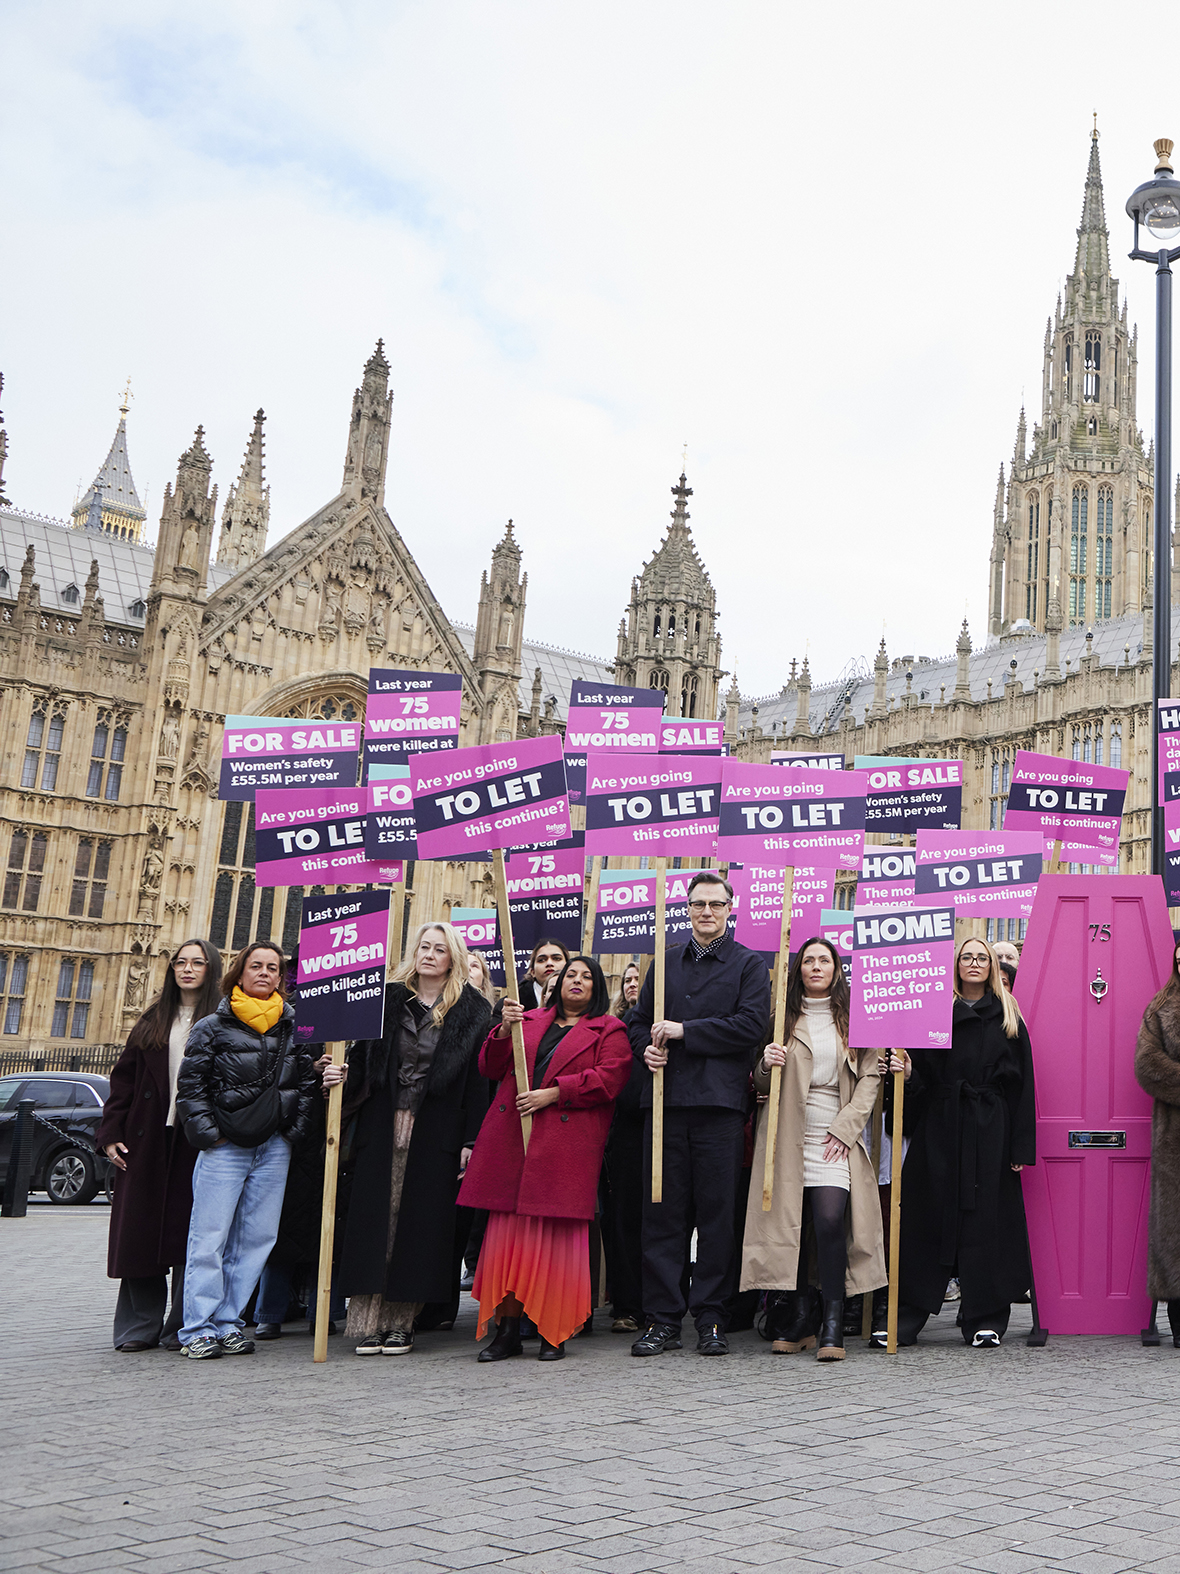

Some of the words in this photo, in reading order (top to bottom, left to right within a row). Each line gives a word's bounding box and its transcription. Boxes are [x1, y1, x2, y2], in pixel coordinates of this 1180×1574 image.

[376, 680, 401, 690] Last
[404, 681, 432, 691] year
[400, 697, 428, 714] 75
[578, 693, 603, 703] Last
[606, 696, 634, 705] year
[369, 716, 456, 732] women
[601, 712, 629, 729] 75
[228, 733, 284, 752] FOR
[292, 729, 356, 749] SALE
[368, 744, 400, 752] were
[403, 739, 438, 750] killed
[440, 740, 453, 748] at
[569, 733, 656, 746] women
[663, 728, 719, 746] SALE
[230, 760, 290, 772] Women's
[294, 758, 333, 768] safety
[231, 774, 282, 786] £55.5M
[285, 774, 308, 784] per
[310, 772, 339, 783] year
[417, 778, 442, 791] Are
[444, 770, 472, 786] you
[475, 758, 517, 778] going
[1016, 770, 1036, 779] Are
[1038, 773, 1058, 782] you
[1061, 773, 1093, 785] going
[435, 791, 480, 820] TO
[488, 772, 542, 807] LET
[726, 786, 750, 796] Are
[754, 786, 780, 798] you
[784, 782, 823, 796] going
[1026, 789, 1058, 808] TO
[1066, 792, 1107, 811] LET
[464, 822, 492, 837] this
[495, 800, 565, 830] continue?
[742, 806, 783, 828] TO
[792, 804, 844, 826] LET
[1041, 816, 1060, 826] this
[1063, 818, 1117, 829] continue?
[546, 822, 566, 830] Refuge
[764, 838, 790, 849] this
[793, 834, 860, 848] continue?
[920, 850, 941, 859] Are
[944, 848, 966, 859] you
[969, 844, 1004, 857] going
[934, 866, 970, 887] TO
[978, 860, 1023, 883] LET
[954, 893, 976, 904] this
[979, 886, 1037, 901] continue?
[308, 908, 332, 922] Last
[335, 902, 361, 918] year
[330, 923, 357, 948] 75
[857, 913, 952, 944] HOME
[1088, 924, 1111, 942] 75
[301, 942, 384, 974] women
[860, 955, 889, 968] The
[893, 950, 931, 965] most
[862, 966, 946, 983] dangerous
[300, 985, 330, 998] were
[332, 974, 365, 991] killed
[368, 972, 380, 983] at
[864, 985, 905, 1001] place
[909, 981, 931, 993] for
[935, 982, 944, 990] a
[347, 987, 381, 1002] home
[864, 999, 922, 1013] woman
[929, 1031, 949, 1039] Refuge
